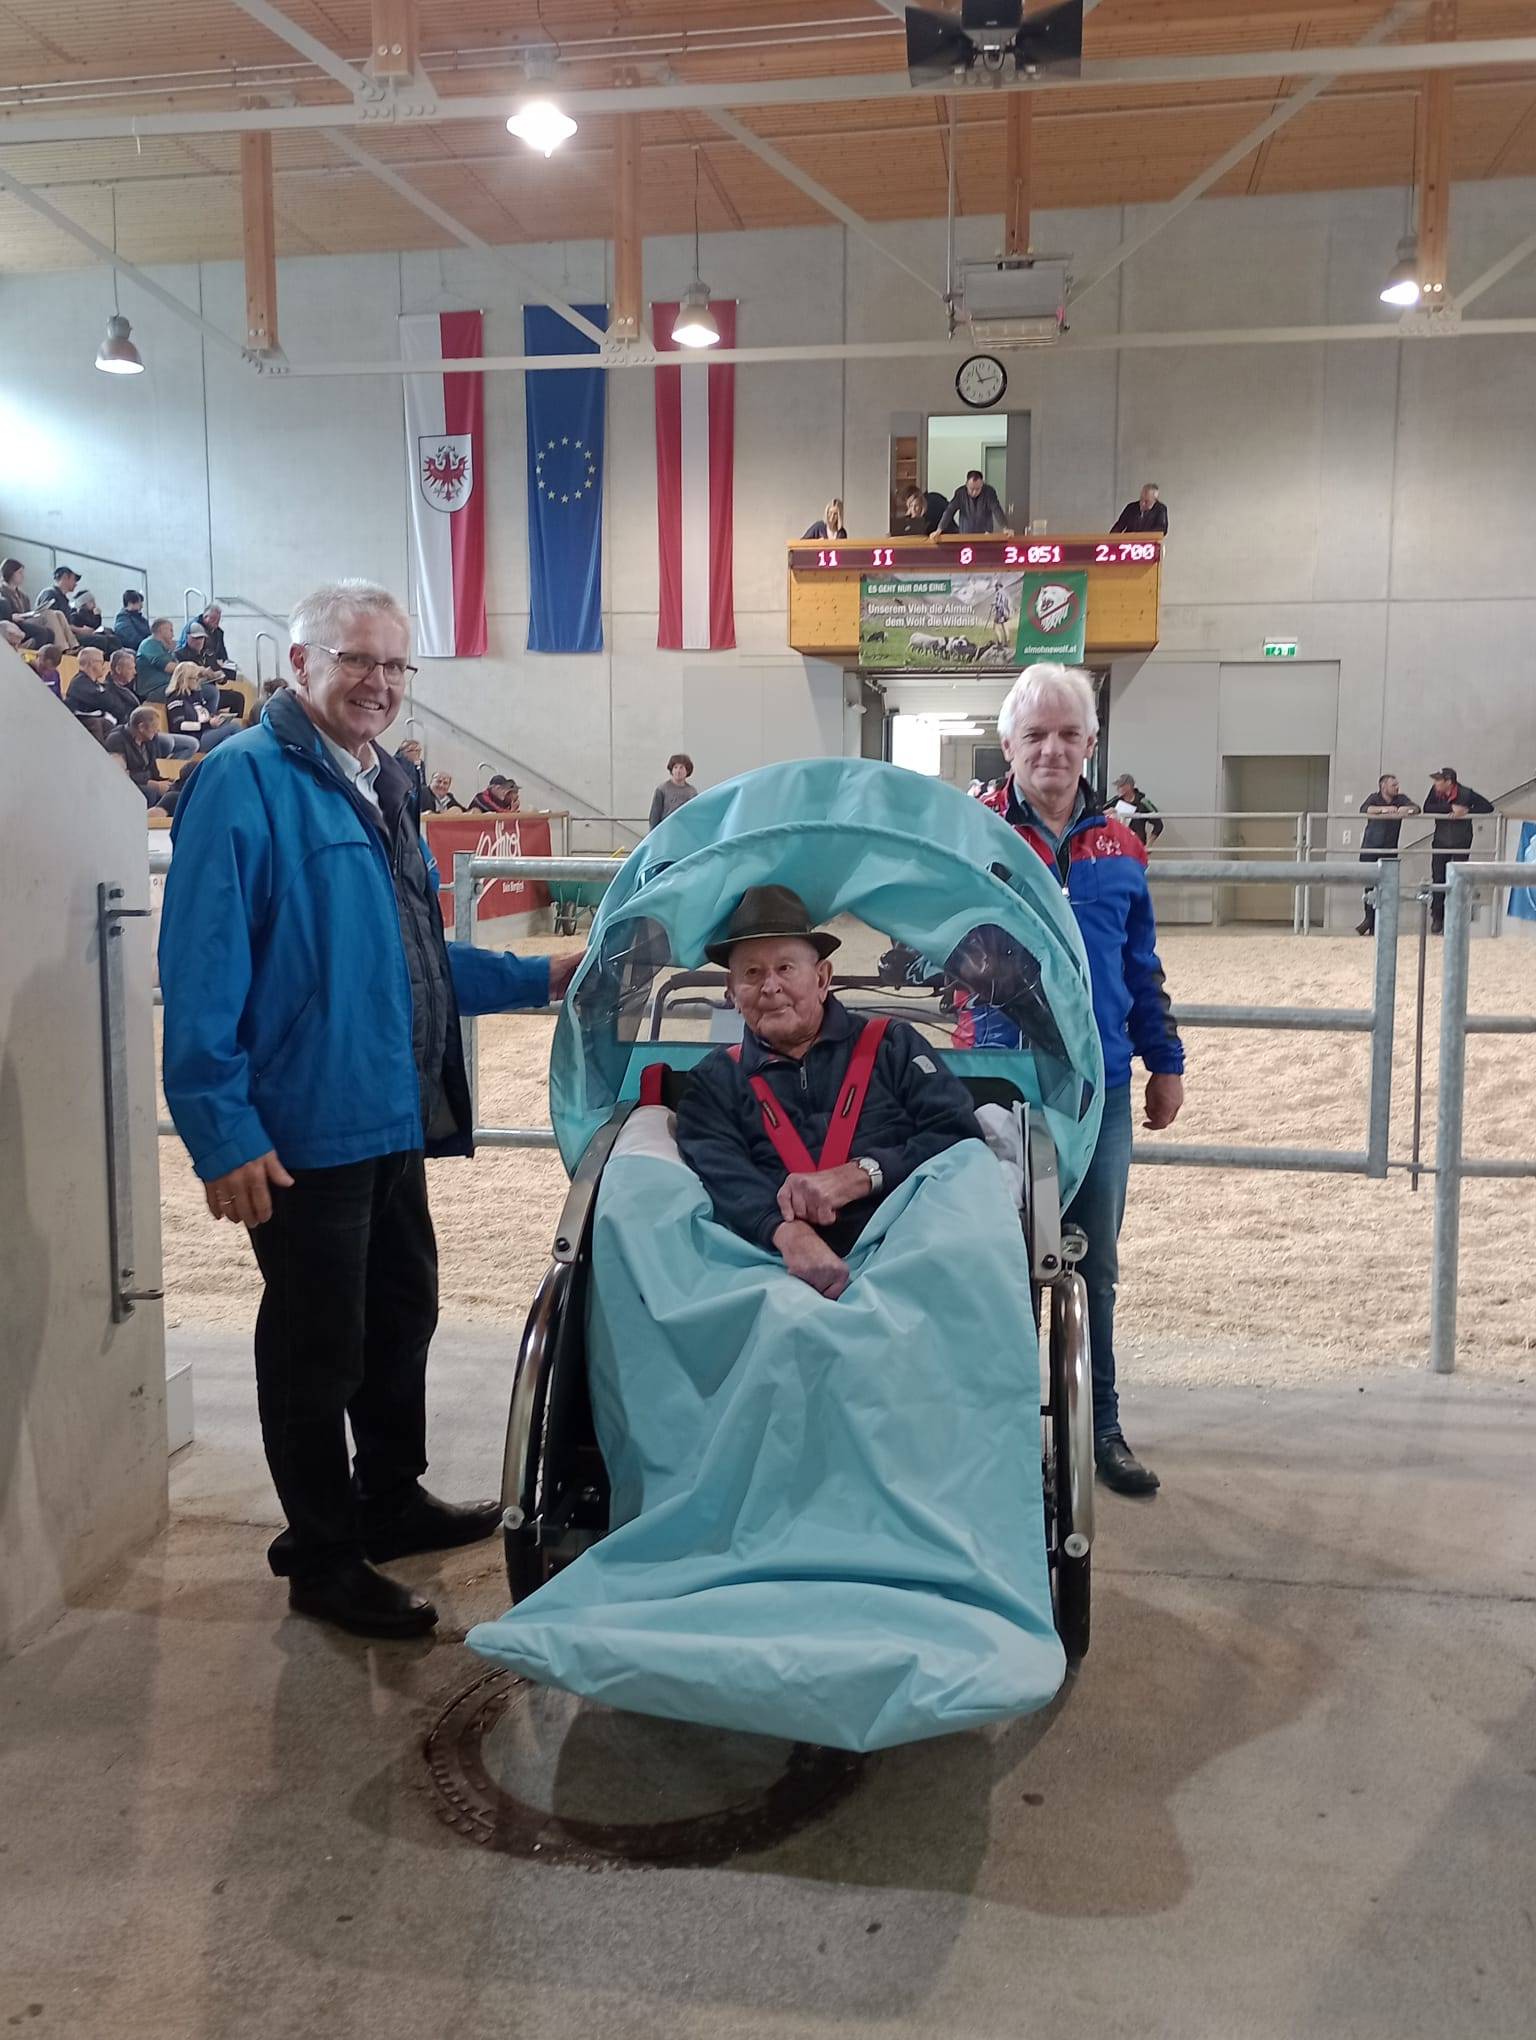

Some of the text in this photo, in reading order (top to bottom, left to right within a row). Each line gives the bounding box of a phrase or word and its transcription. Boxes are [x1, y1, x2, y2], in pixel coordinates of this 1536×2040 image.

[817, 550, 838, 567] 11
[959, 547, 973, 565] 0
[1004, 545, 1061, 564] 3.051
[1095, 543, 1155, 562] 2.700
[879, 584, 896, 593] GEHT
[897, 583, 912, 593] NUR
[913, 583, 928, 593] DAS
[868, 603, 906, 614] Unserem
[907, 603, 928, 614] Vieh
[929, 603, 943, 614] die
[885, 616, 904, 627] dem
[905, 616, 926, 627] Wolf
[927, 616, 941, 627] die
